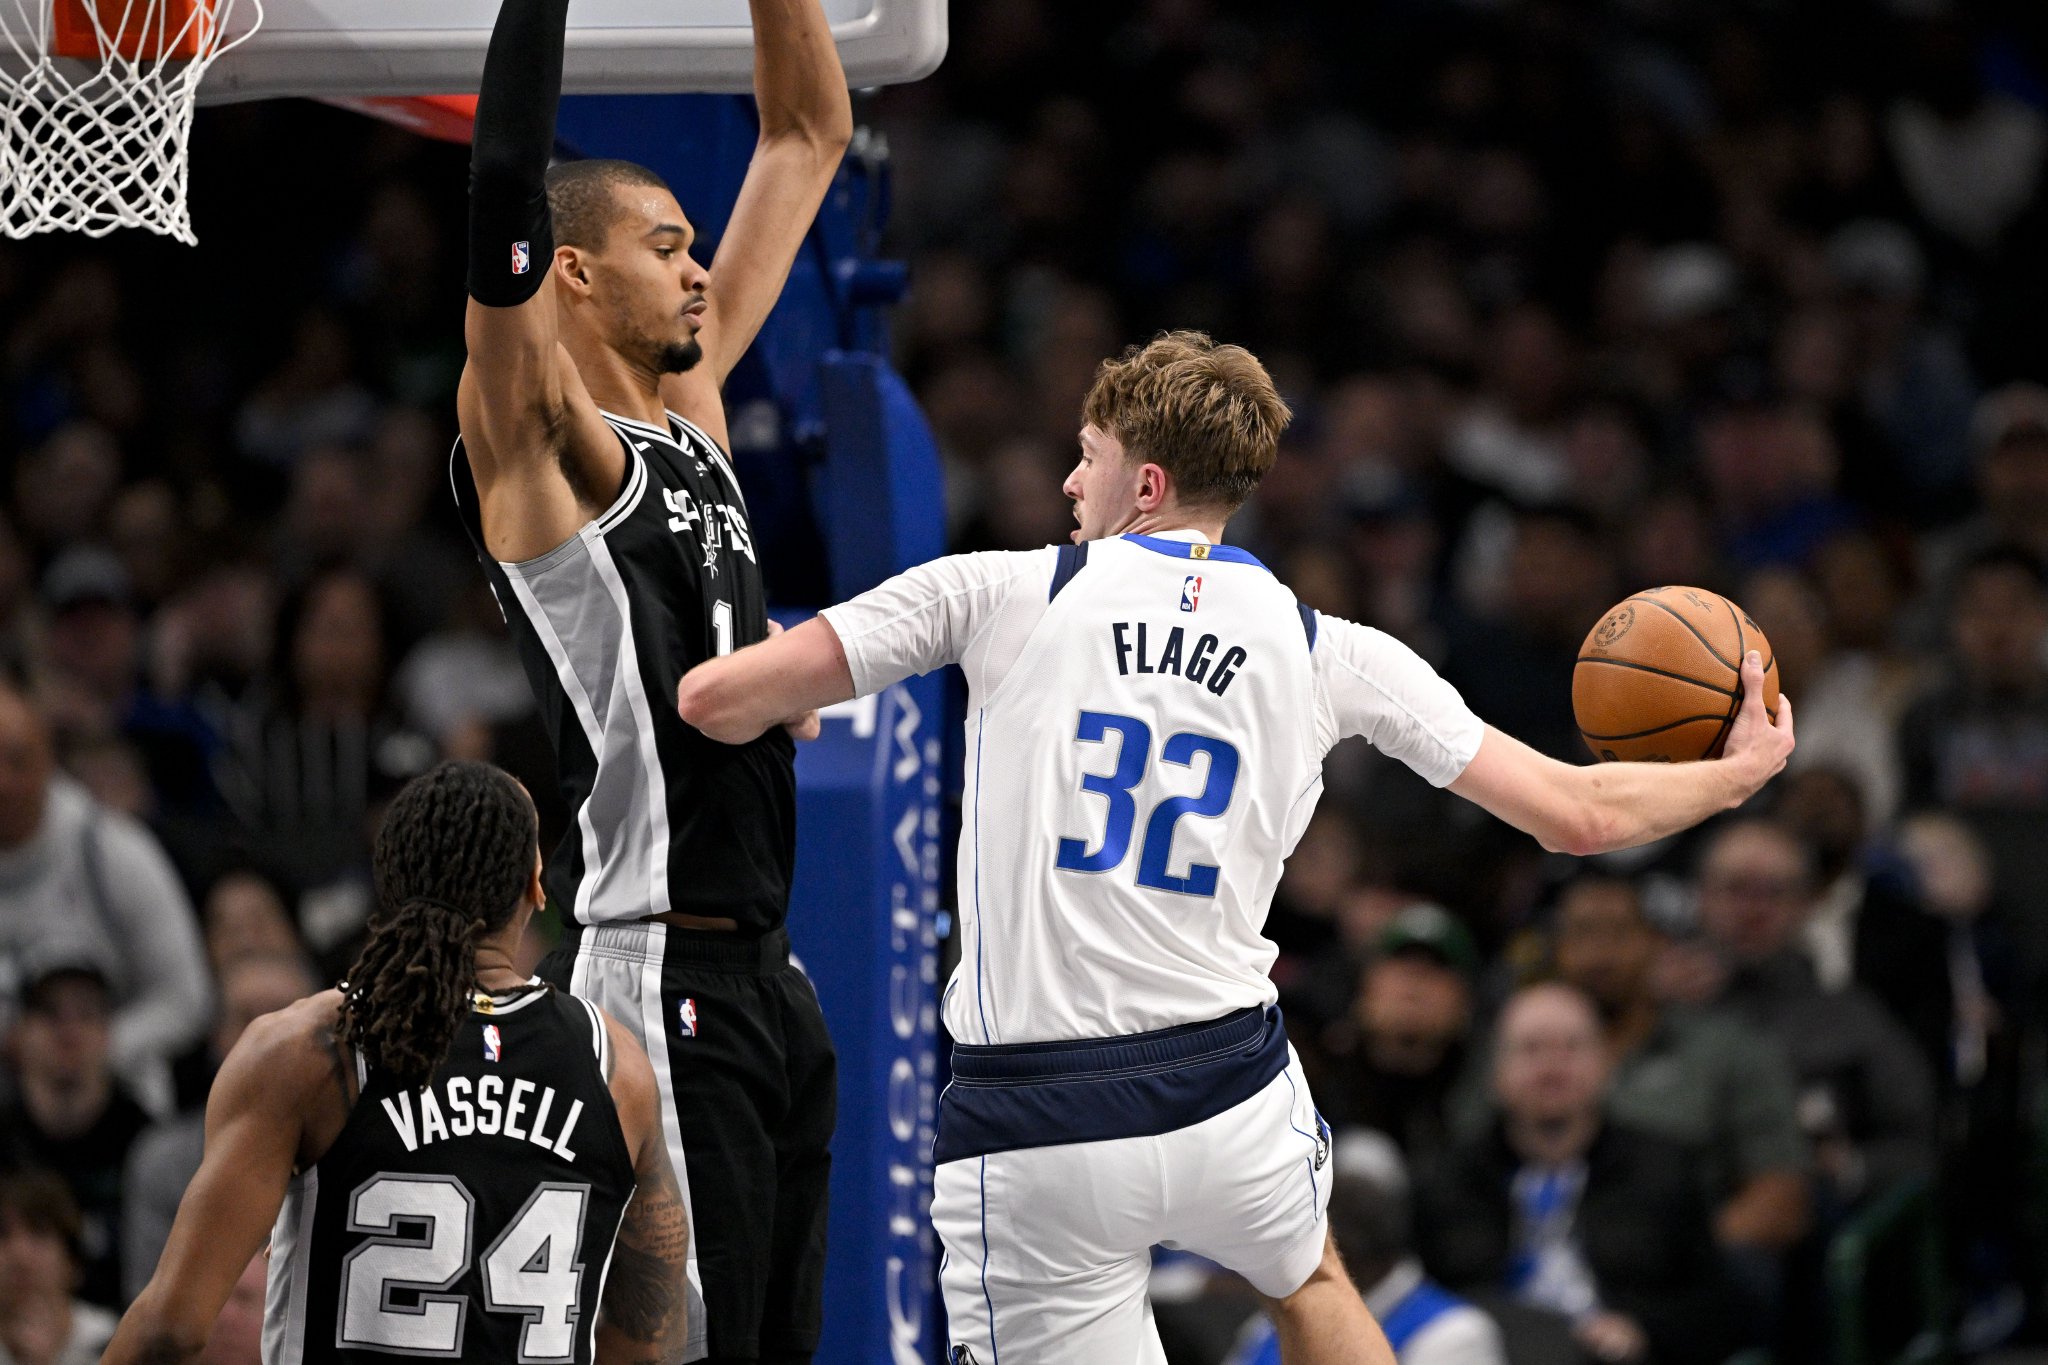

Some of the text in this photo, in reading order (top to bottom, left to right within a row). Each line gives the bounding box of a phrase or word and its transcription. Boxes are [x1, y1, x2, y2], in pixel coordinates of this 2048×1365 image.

[1112, 622, 1248, 697] FLAGG
[1054, 709, 1241, 898] 32
[380, 1074, 584, 1162] VASSELL
[336, 1171, 591, 1364] 24
